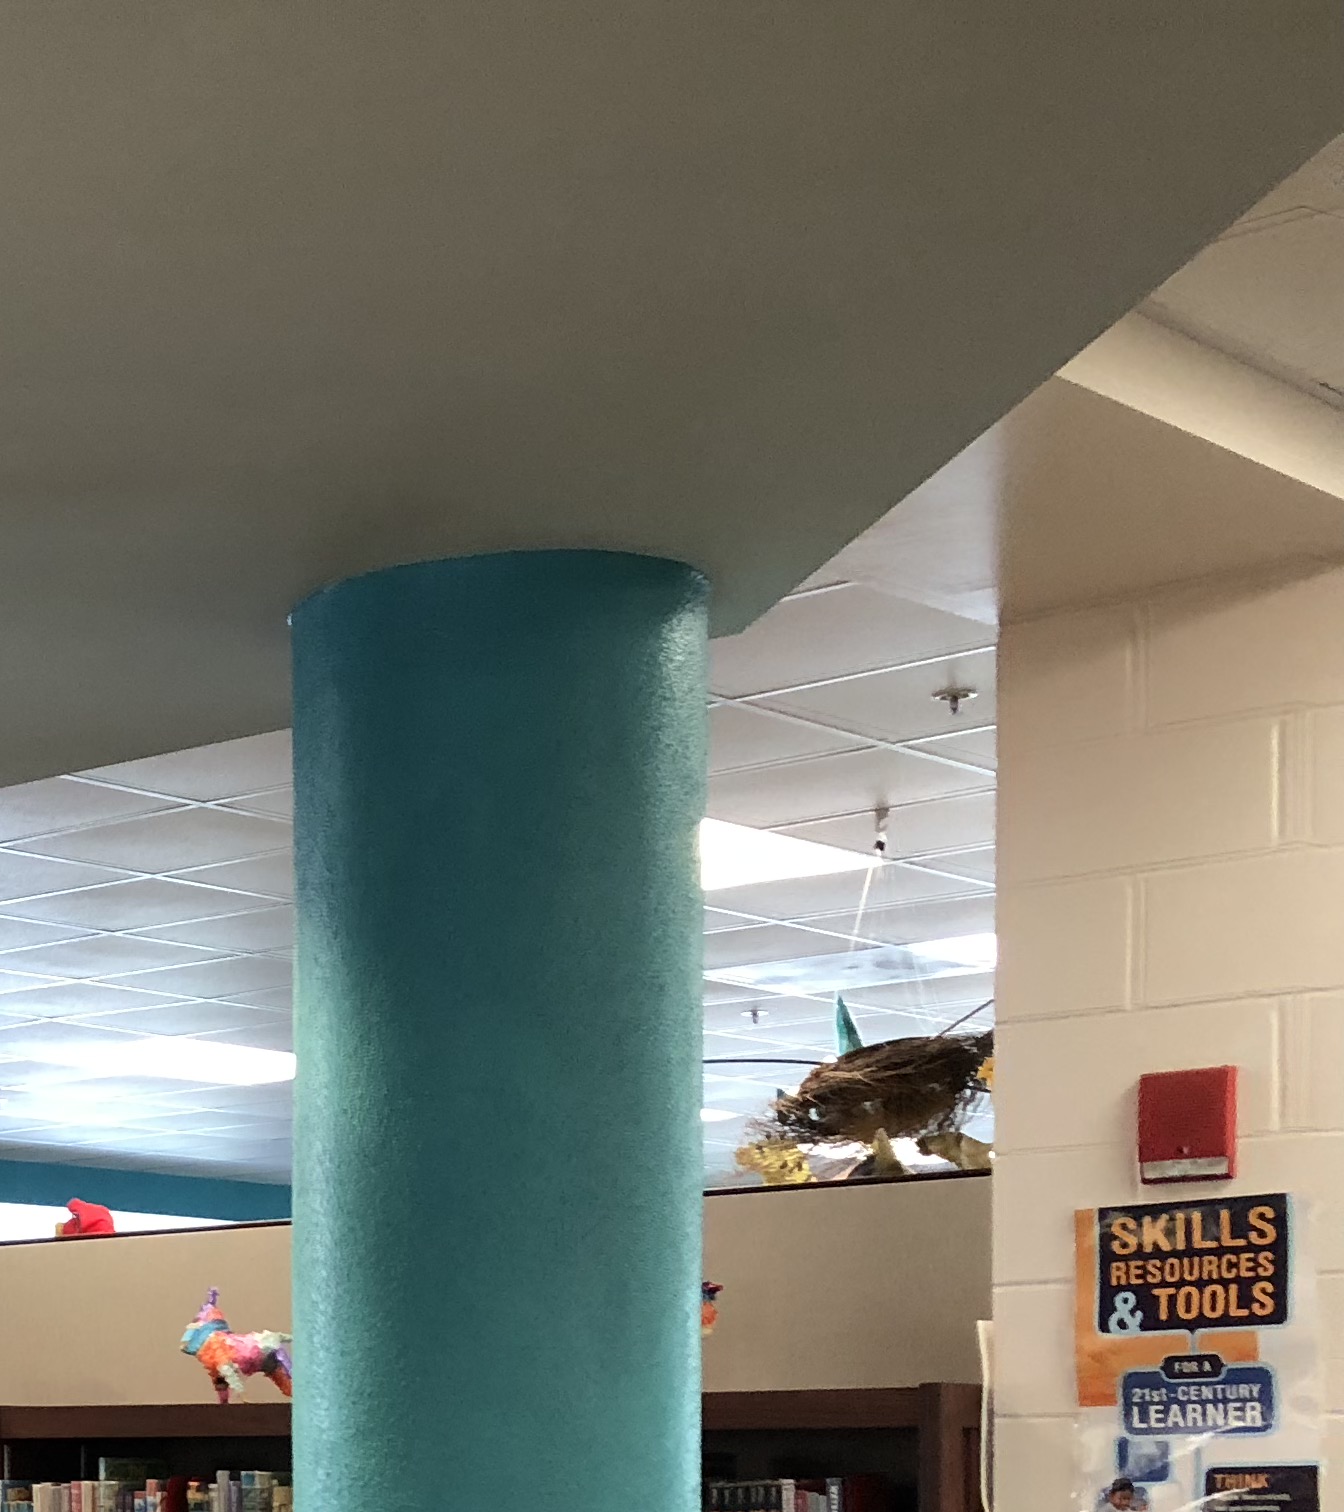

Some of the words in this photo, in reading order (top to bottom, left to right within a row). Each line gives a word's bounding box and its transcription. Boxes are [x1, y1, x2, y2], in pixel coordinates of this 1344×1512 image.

[1111, 1205, 1278, 1256] SKILLS
[1109, 1251, 1275, 1287] RESOURCES
[1108, 1291, 1144, 1332] &
[1151, 1280, 1275, 1322] TOOLS
[1173, 1361, 1200, 1374] FOR
[1202, 1360, 1212, 1373] A
[1131, 1383, 1261, 1403] 21st-CENTURY
[1131, 1401, 1262, 1429] LEARNER
[1214, 1473, 1269, 1489] THINK
